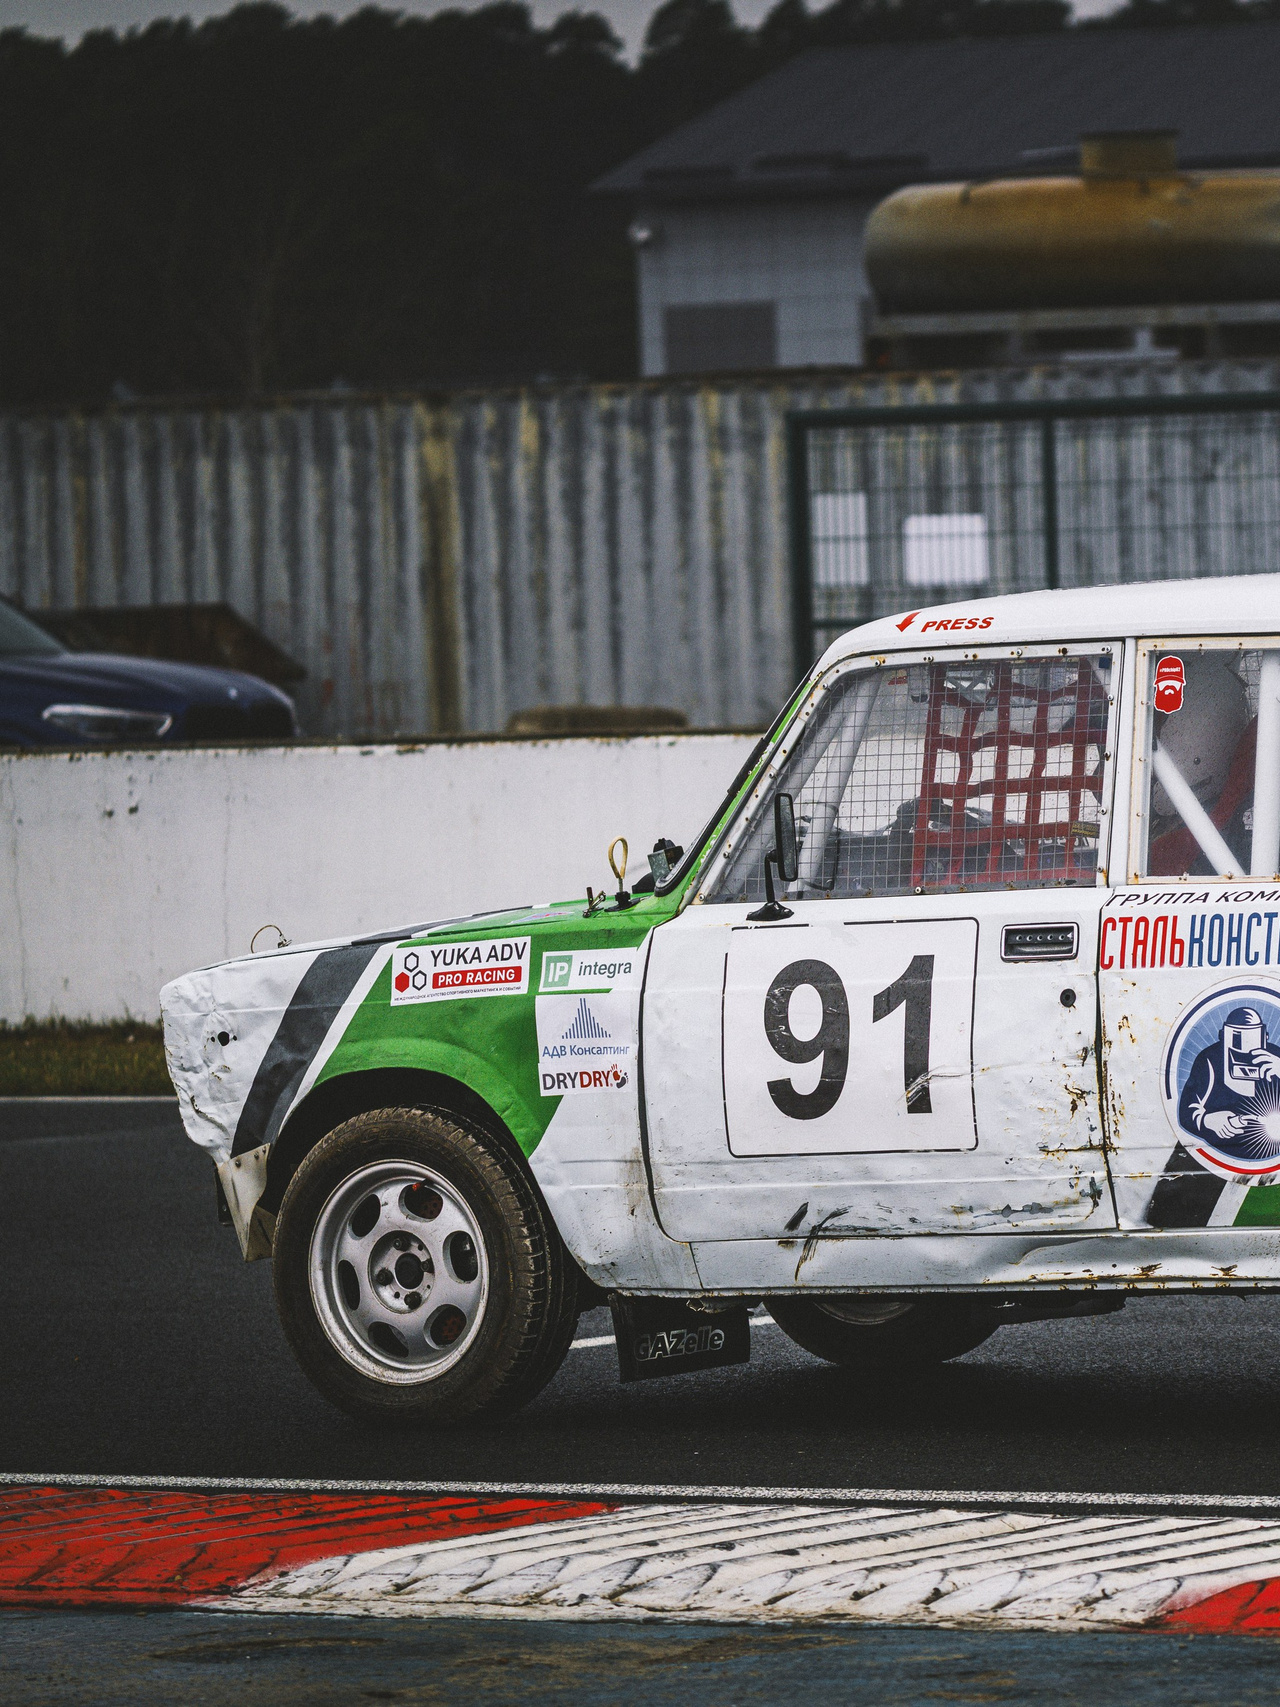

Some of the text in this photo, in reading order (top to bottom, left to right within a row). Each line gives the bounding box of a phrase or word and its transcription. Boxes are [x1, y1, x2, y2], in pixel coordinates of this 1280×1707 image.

[921, 617, 995, 632] PRESS
[1104, 891, 1209, 907] ГРУППА
[430, 942, 527, 968] YUKA ADV
[438, 968, 516, 987] PRO RACING
[549, 961, 632, 982] IP integra
[764, 954, 935, 1121] 91
[542, 1044, 630, 1059] АДВ Консалтинг
